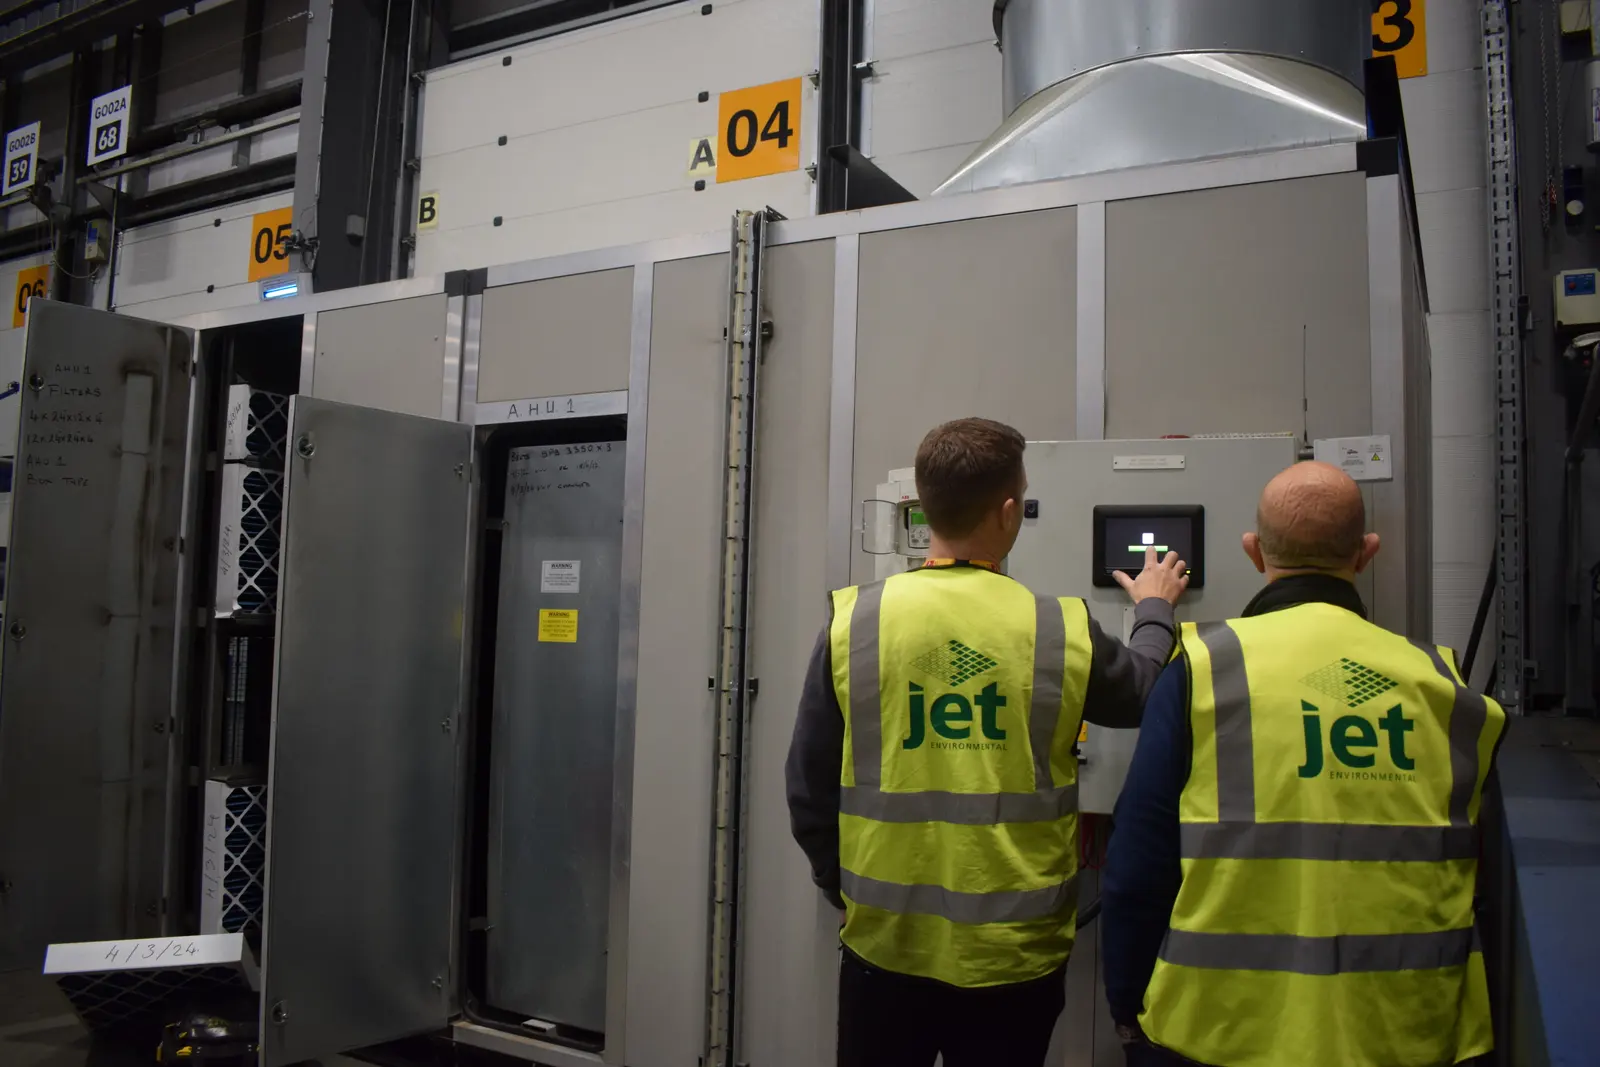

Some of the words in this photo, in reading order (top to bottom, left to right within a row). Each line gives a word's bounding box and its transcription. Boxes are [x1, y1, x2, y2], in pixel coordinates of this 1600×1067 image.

[98, 127, 118, 151] 68
[726, 101, 793, 157] 04
[690, 139, 716, 170] A
[11, 160, 28, 182] 39
[419, 197, 436, 224] B
[255, 222, 292, 263] 05
[566, 398, 575, 413] 1
[566, 445, 593, 455] 3350
[902, 681, 1006, 750] jet
[930, 742, 1008, 751] ENVIRONMENTAL
[1298, 699, 1415, 778] jet
[1329, 771, 1417, 782] ENVIRONMENTAL
